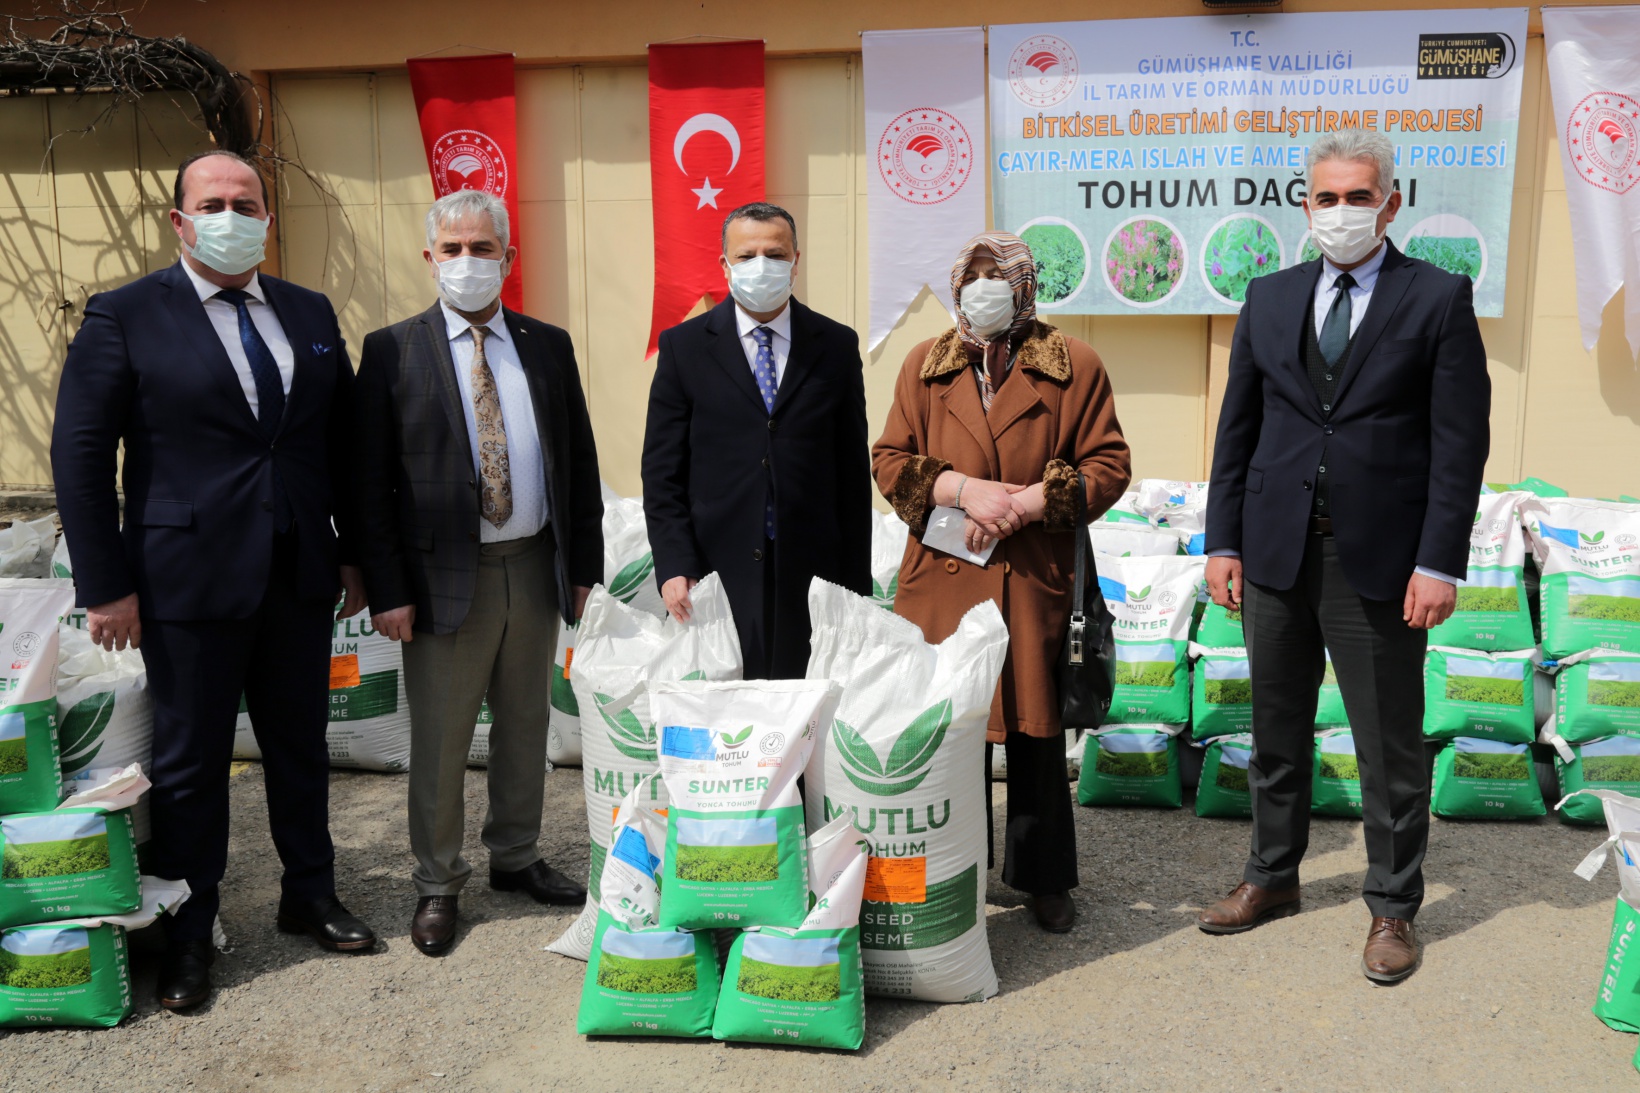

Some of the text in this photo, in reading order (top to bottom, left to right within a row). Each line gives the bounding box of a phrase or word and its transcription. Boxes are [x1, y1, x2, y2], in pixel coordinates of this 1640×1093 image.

[1230, 30, 1260, 48] T.C.
[1138, 50, 1352, 77] GÜMÜŞHANE VALİLİĞİ
[1420, 48, 1500, 66] GÜMÜŞHANE
[1419, 64, 1484, 76] VALİLİĞİ
[1083, 74, 1410, 100] İL TARIM VE ORMAN MÜDÜRLÜĞÜ
[1022, 104, 1482, 138] BİTKİSEL ÜRETİMİ GELİŞTİRME PROJESİ
[998, 149, 1134, 177] ÇAYIR-MERA
[1142, 147, 1206, 169] ISLAH
[1213, 146, 1244, 168] VE
[1410, 140, 1506, 168] PROJESİ
[1078, 178, 1218, 209] TOHUM
[1470, 544, 1503, 556] NTER
[1570, 554, 1633, 569] SUNTER
[1541, 582, 1549, 640] SUNTER
[333, 618, 377, 639] TLU
[48, 714, 62, 798] SUNTER
[716, 750, 750, 762] MUTLU
[594, 768, 662, 800] MUT
[688, 776, 770, 794] SUNTER
[727, 800, 758, 808] TOHUMU
[824, 795, 950, 835] MUTLU
[124, 813, 144, 896] SUNTER
[56, 904, 71, 912] kg
[728, 912, 740, 920] kg
[864, 914, 914, 926] SEED
[864, 933, 914, 944] SEME
[112, 924, 130, 1009] SUNTER
[1600, 920, 1636, 1004] SUNTER
[772, 1028, 799, 1038] 10 kg
